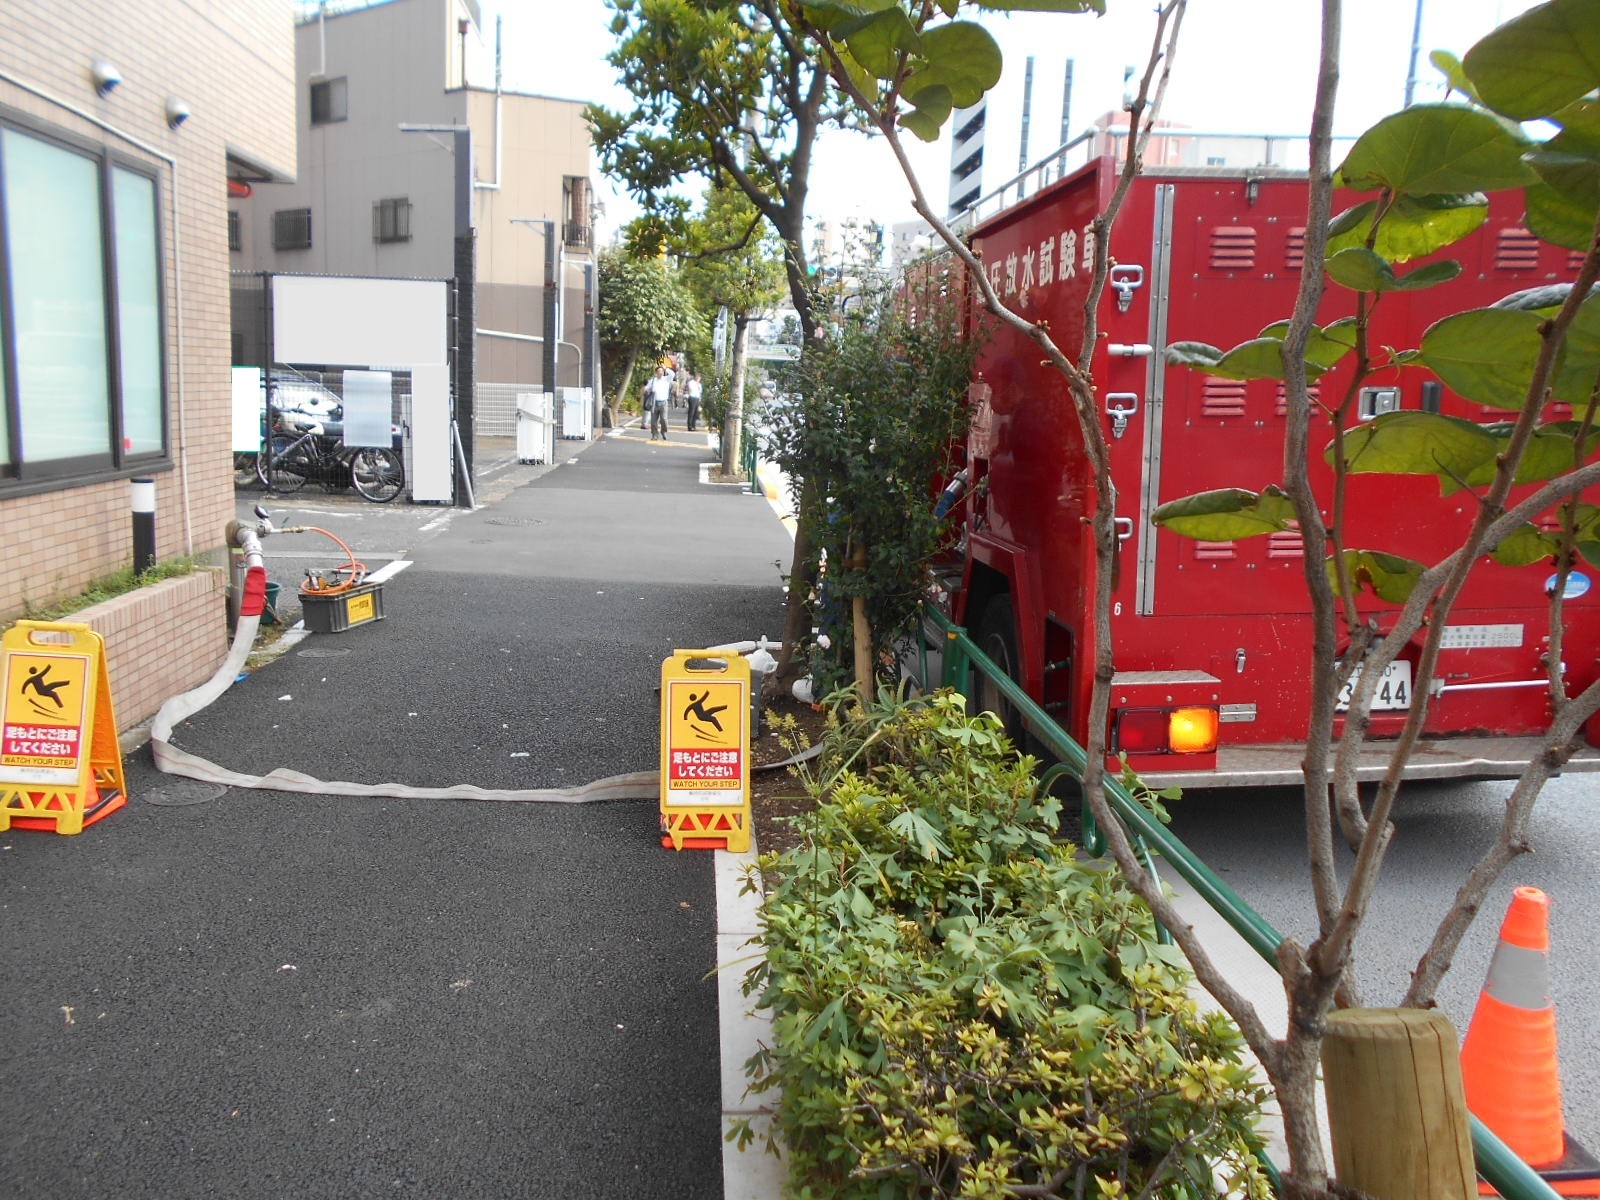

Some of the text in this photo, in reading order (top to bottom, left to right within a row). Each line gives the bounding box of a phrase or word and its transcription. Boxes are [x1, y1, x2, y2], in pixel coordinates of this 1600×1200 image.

[1114, 601, 1121, 616] 6
[5, 726, 78, 742] 足もとにご注意
[10, 740, 71, 755] してください
[4, 756, 31, 765] WATCH
[54, 759, 74, 767] STEP
[672, 751, 738, 764] 足もとにご注意
[678, 765, 734, 777] してください
[672, 780, 738, 788] WATCH YOUR STEP
